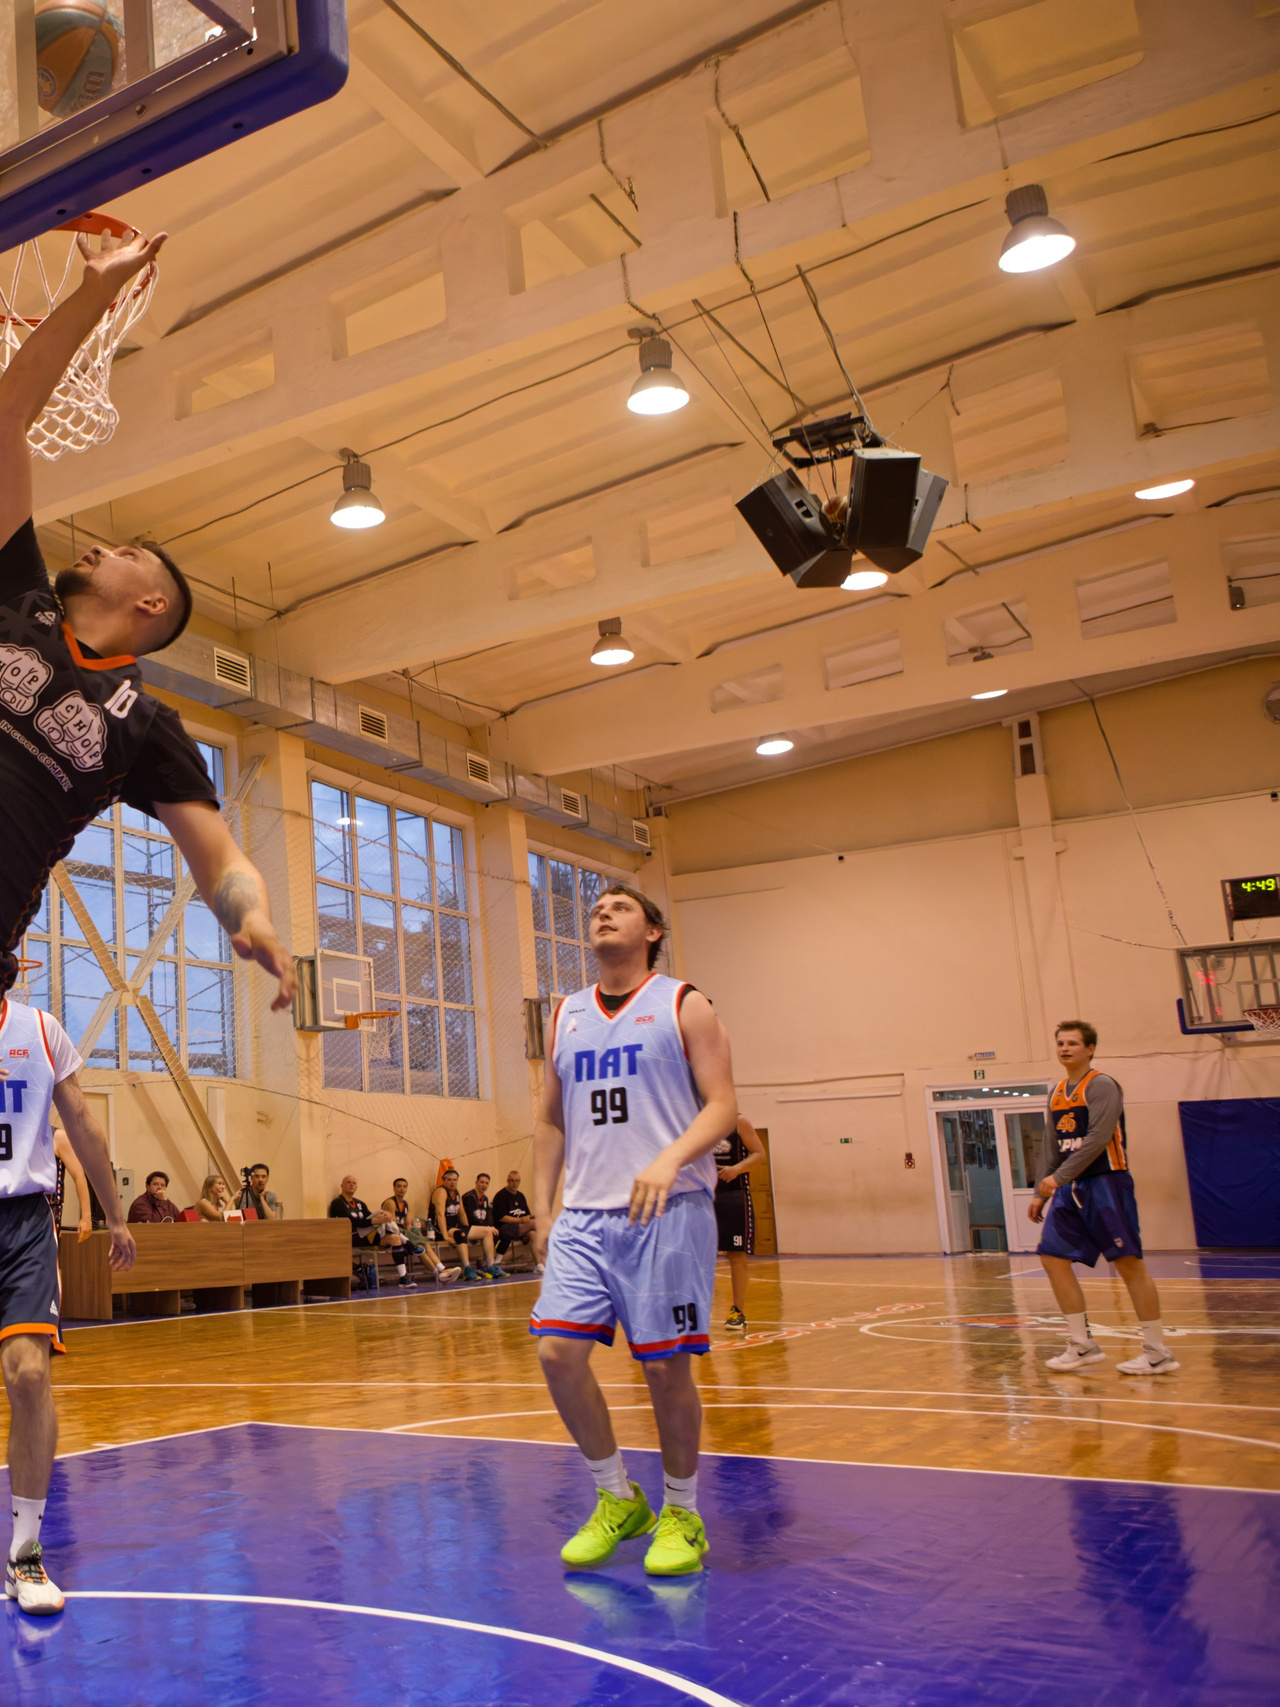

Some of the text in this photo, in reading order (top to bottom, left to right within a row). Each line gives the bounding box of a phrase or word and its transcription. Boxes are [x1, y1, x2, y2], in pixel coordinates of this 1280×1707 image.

[104, 679, 138, 719] 10
[0, 719, 13, 734] IN
[10, 729, 40, 756] GOOD
[64, 704, 100, 760] CHOP
[1241, 878, 1276, 892] 4:49
[575, 1043, 643, 1083] ПАТ
[591, 1087, 629, 1126] 99
[672, 1302, 698, 1334] 99
